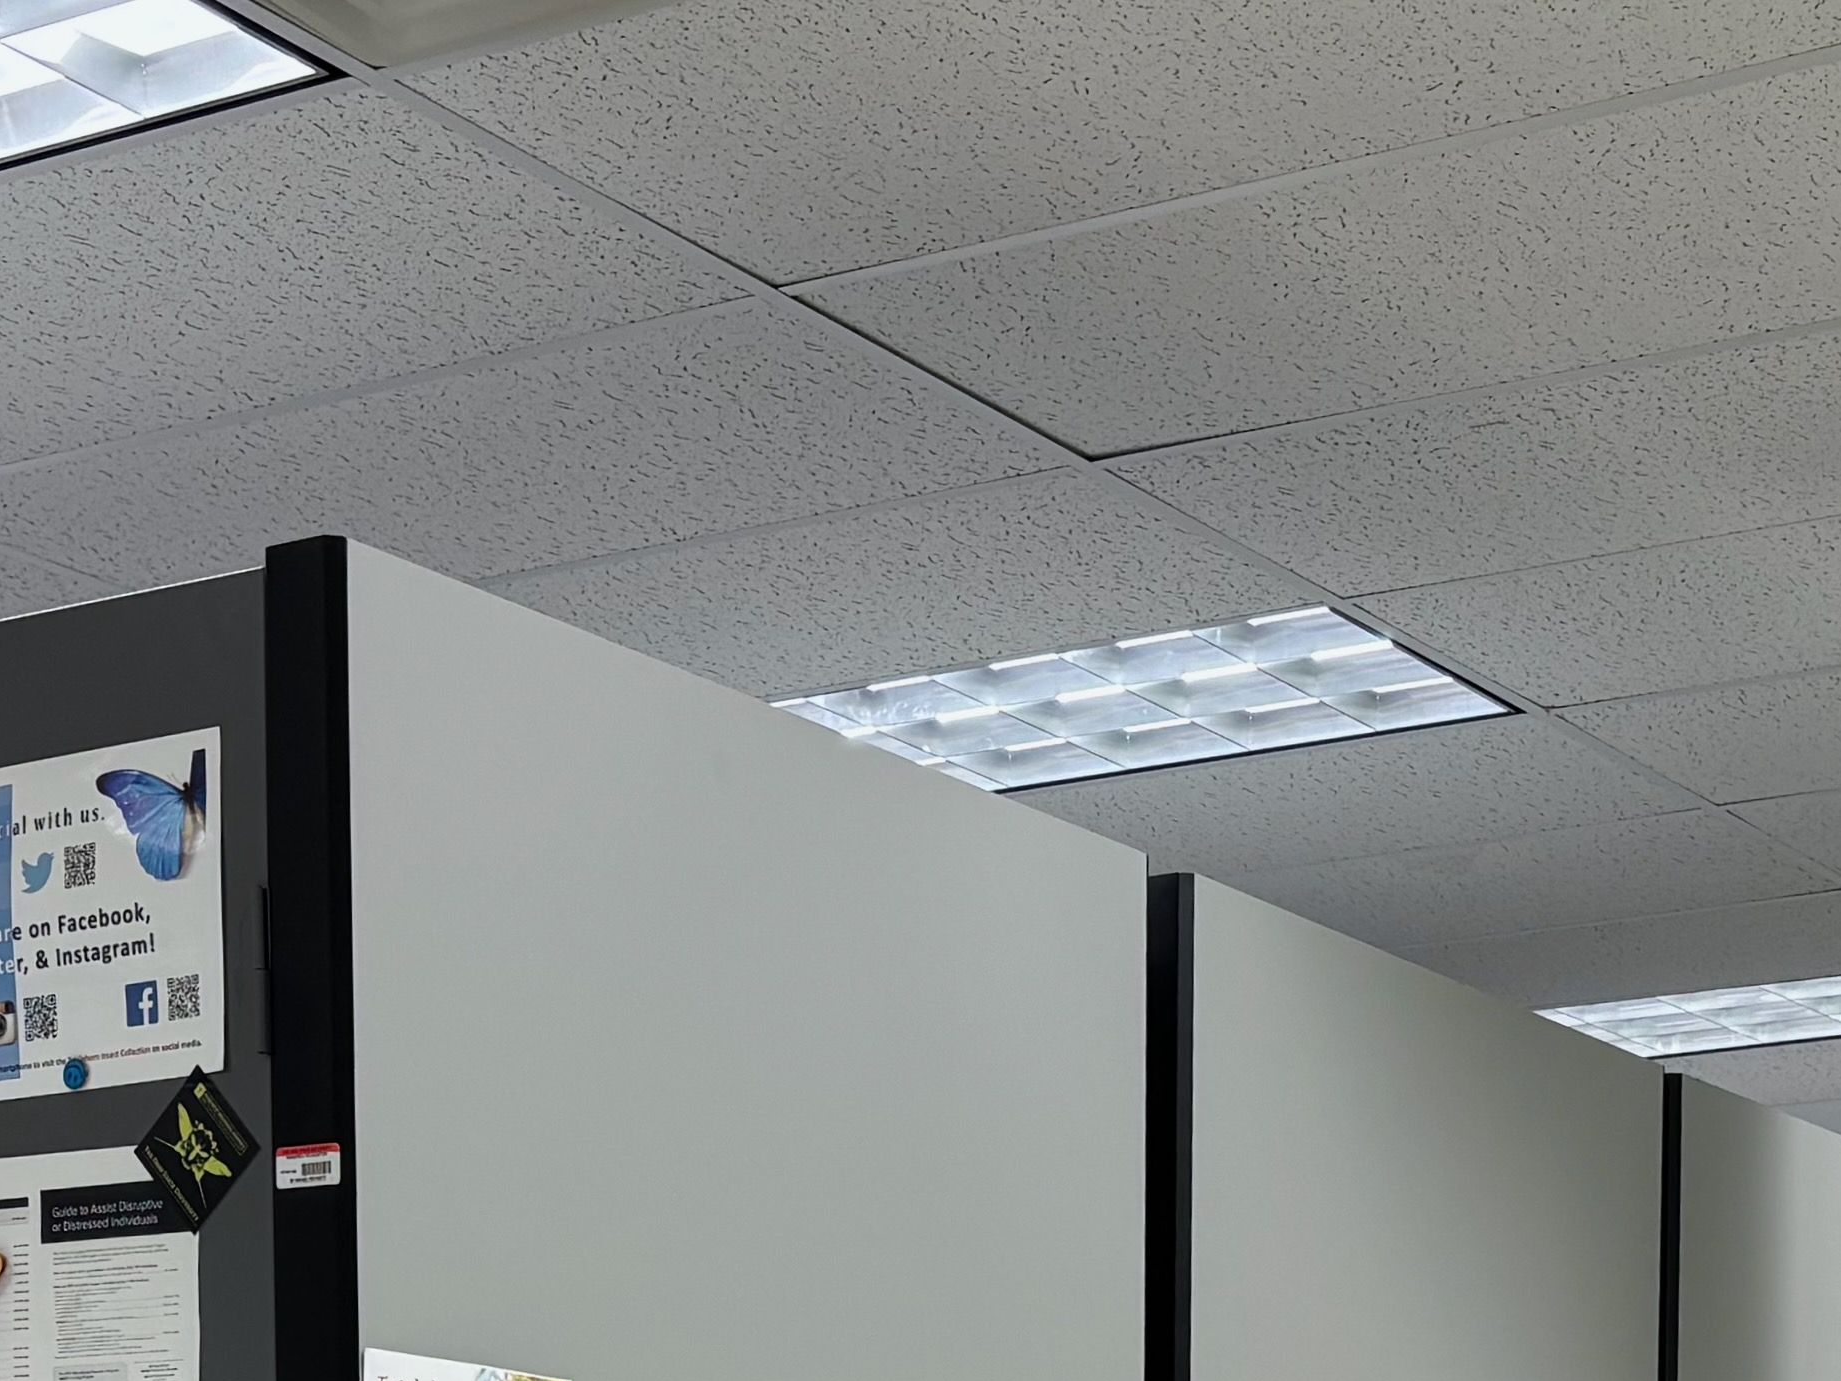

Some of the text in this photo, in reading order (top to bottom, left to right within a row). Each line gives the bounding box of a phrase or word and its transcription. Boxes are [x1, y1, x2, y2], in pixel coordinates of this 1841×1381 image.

[34, 807, 73, 832] with
[80, 806, 106, 823] us.
[29, 920, 51, 939] on
[58, 901, 151, 935] Facebook,
[36, 950, 49, 969] &
[55, 933, 156, 967] Instagram!
[120, 1047, 151, 1058] Collection
[161, 1041, 180, 1052] social
[181, 1039, 203, 1049] media.
[52, 1199, 164, 1218] Guide to Assist Disruptive
[51, 1213, 159, 1232] or Distressed Individuals
